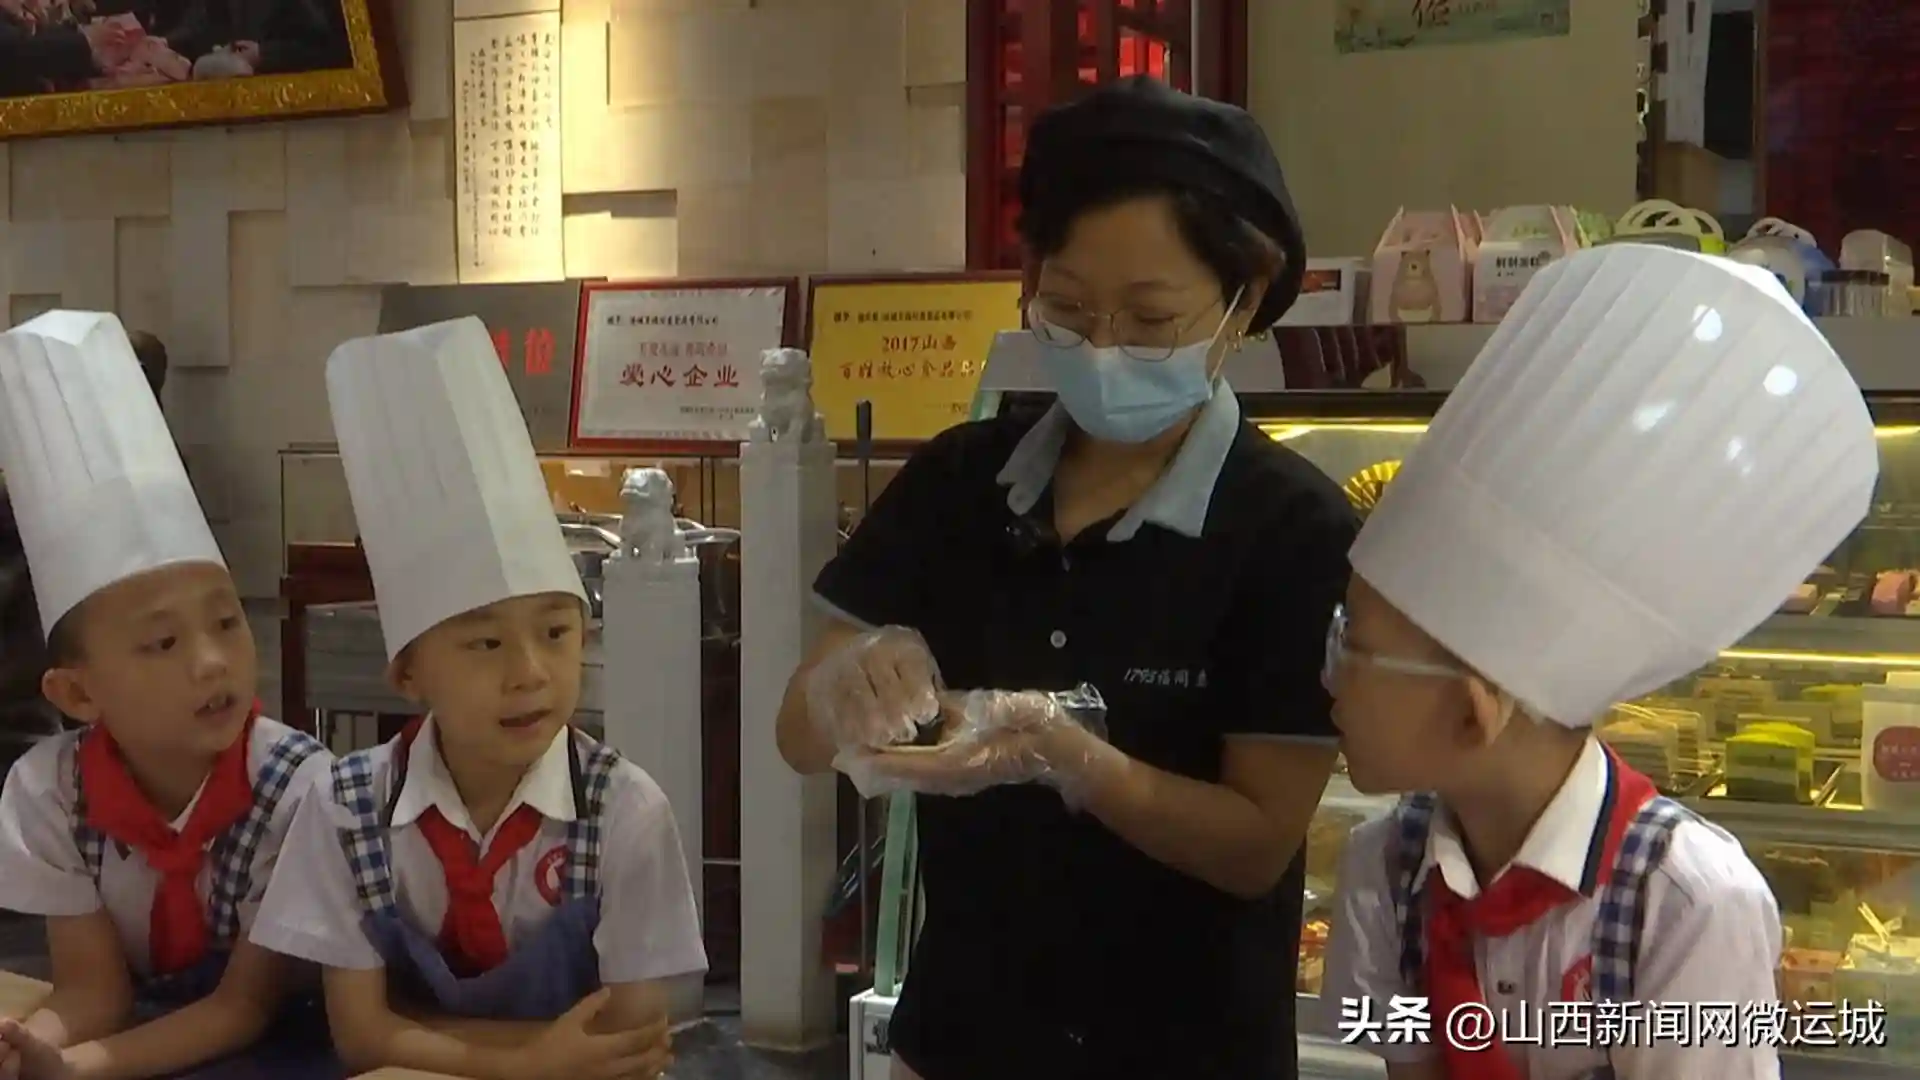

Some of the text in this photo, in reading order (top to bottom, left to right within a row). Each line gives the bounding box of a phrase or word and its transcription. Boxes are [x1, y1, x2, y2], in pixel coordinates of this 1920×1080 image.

[619, 362, 740, 388] 爱心企业
[839, 359, 988, 380] 百姓放心食品品
